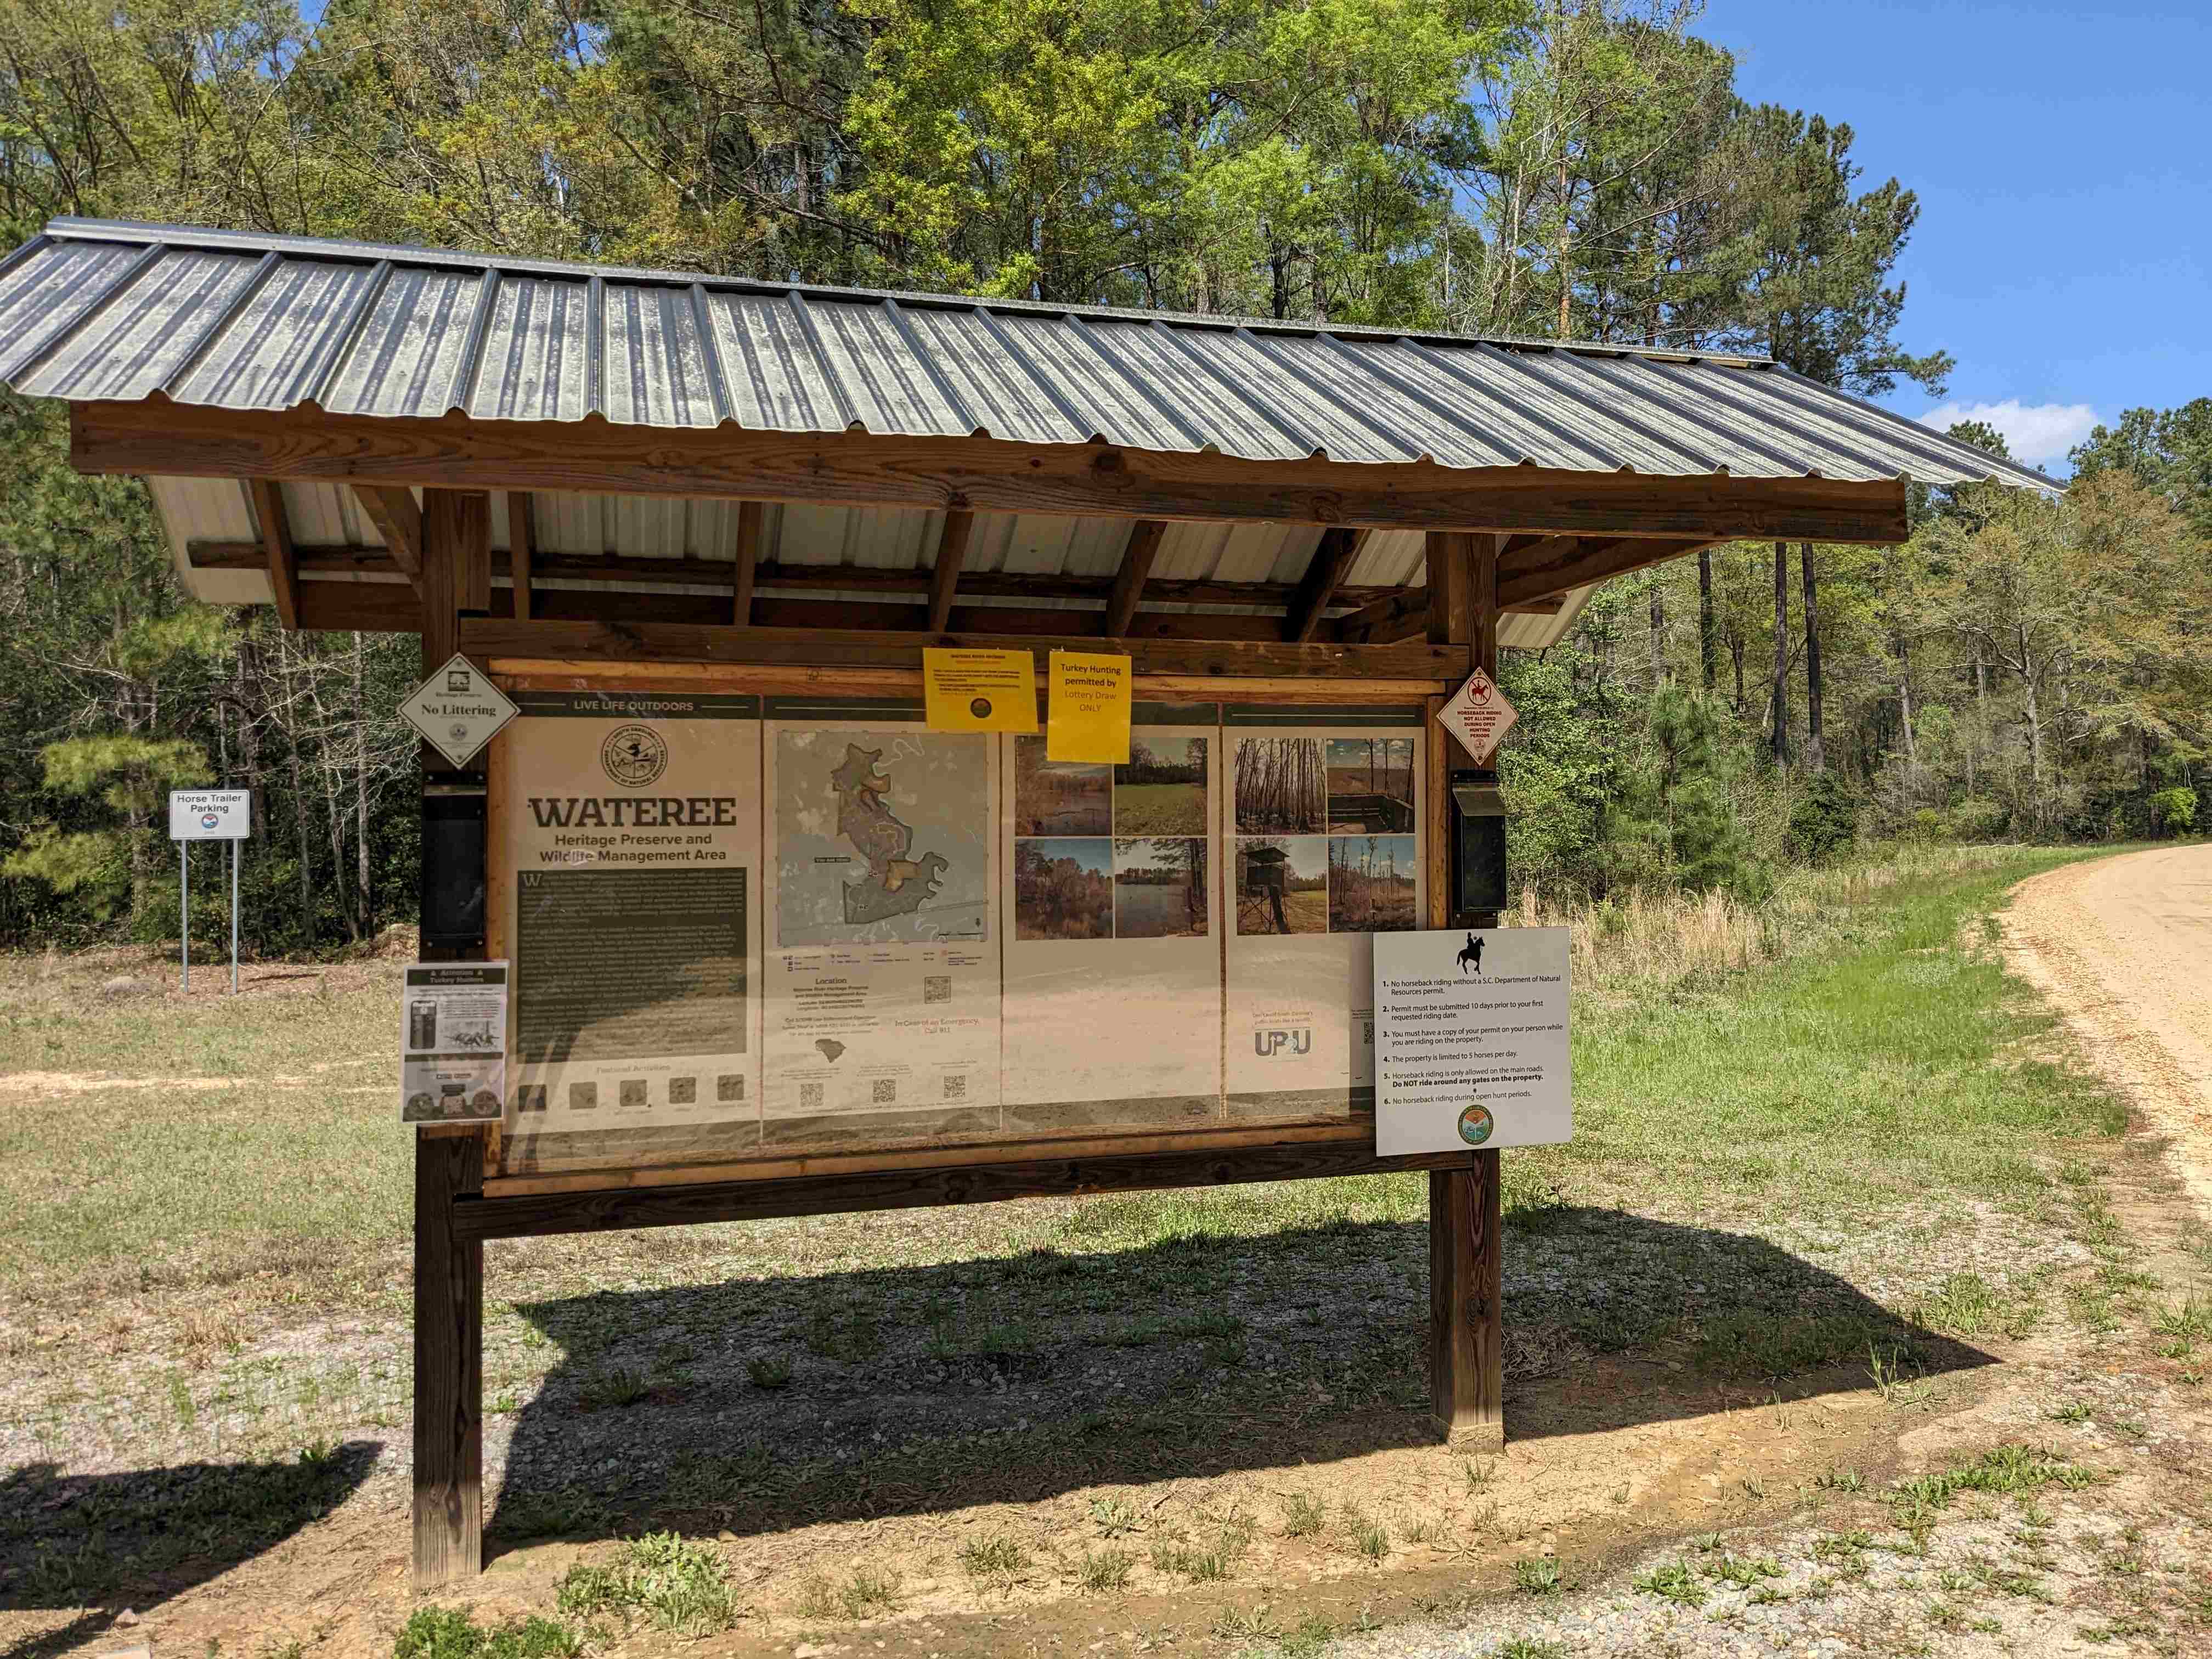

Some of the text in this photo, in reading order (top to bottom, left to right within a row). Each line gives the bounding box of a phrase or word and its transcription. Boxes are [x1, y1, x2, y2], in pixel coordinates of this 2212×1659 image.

[1061, 663, 1121, 675] Turkey Hunting
[1107, 679, 1116, 688] by
[1065, 691, 1093, 700] Lottery
[574, 701, 693, 710] LIVE LIFE OUTDOORS
[421, 704, 496, 717] No Littering
[191, 804, 229, 814] Parking
[528, 798, 737, 827] WATEREE
[555, 833, 712, 848] Heritage Preserve and
[540, 849, 726, 863] Wildlife Management Area
[1434, 979, 1452, 987] riding
[1495, 976, 1531, 985] Department
[1481, 1026, 1500, 1035] permit
[1405, 1055, 1431, 1063] property
[1513, 1074, 1543, 1082] property.
[1508, 1091, 1532, 1099] periods.
